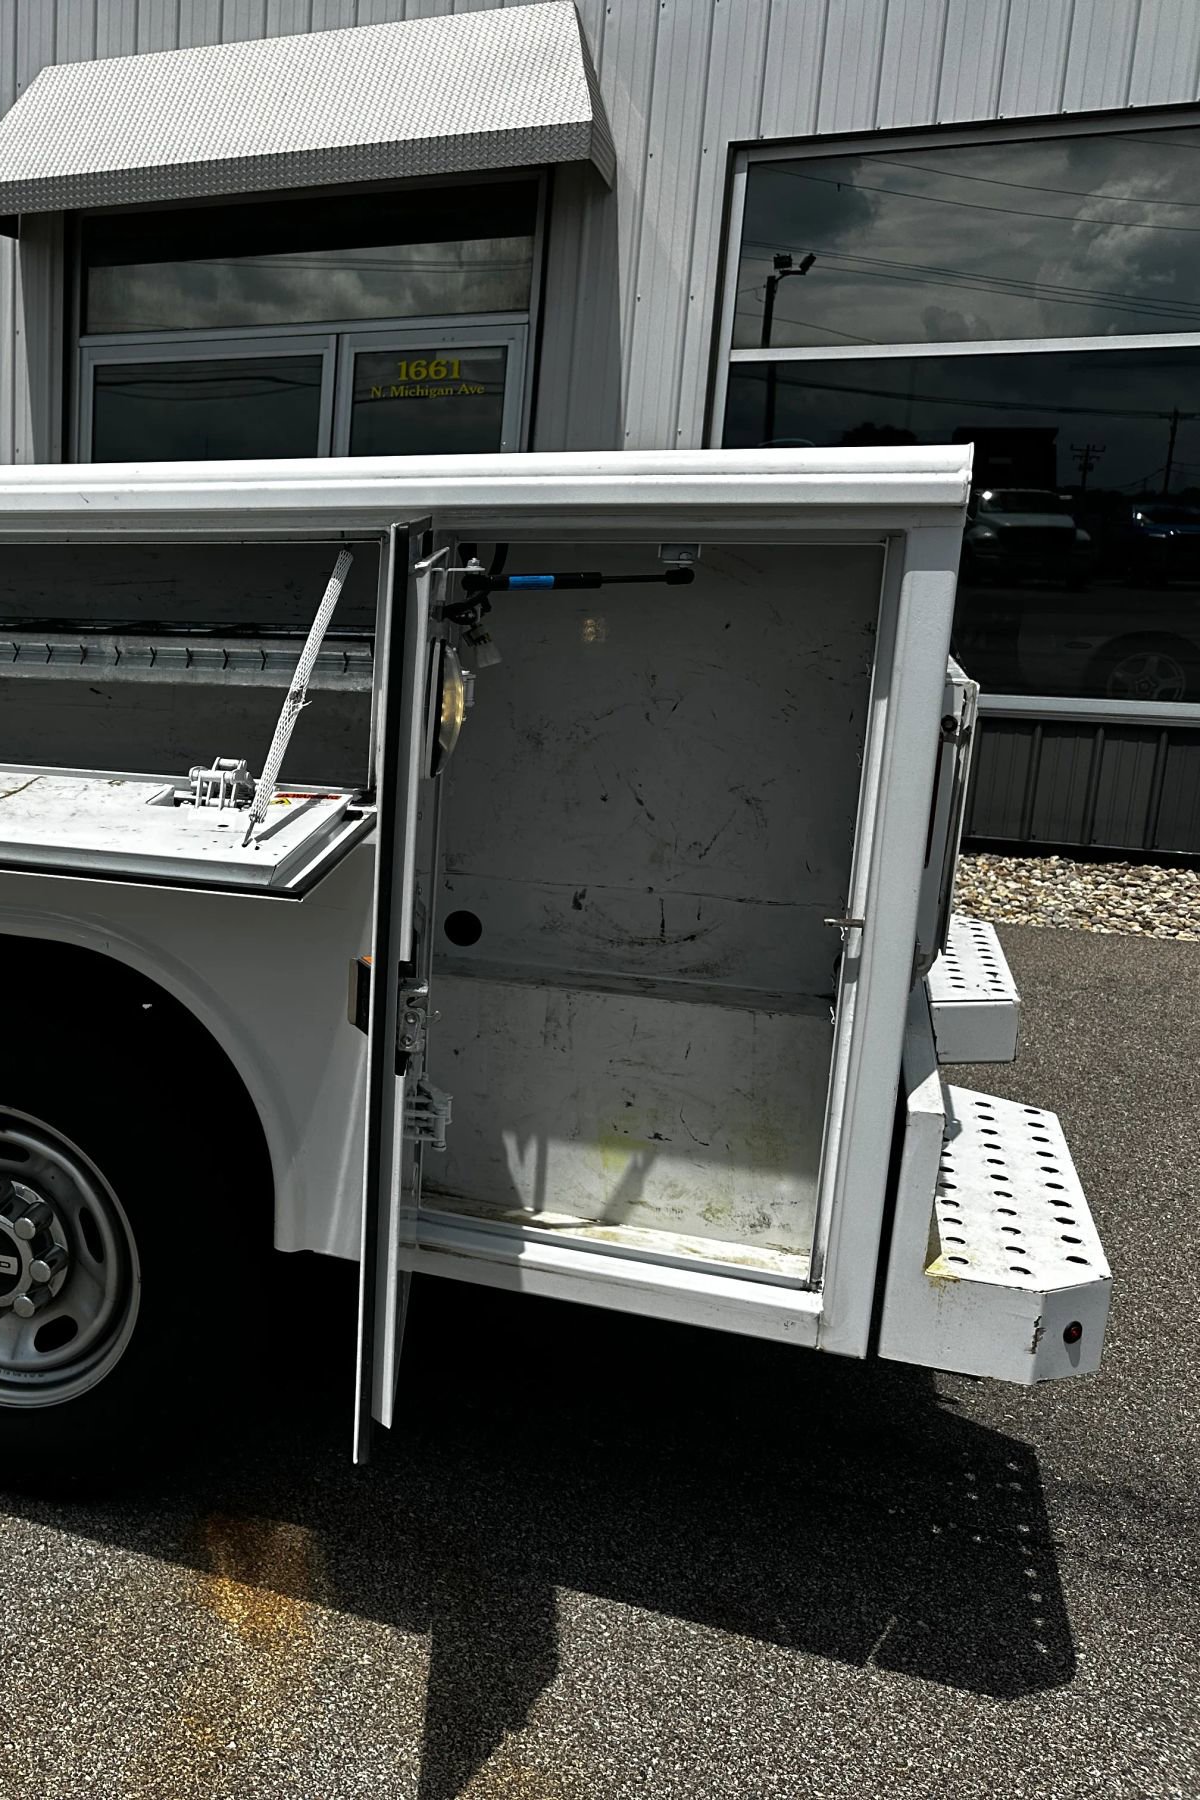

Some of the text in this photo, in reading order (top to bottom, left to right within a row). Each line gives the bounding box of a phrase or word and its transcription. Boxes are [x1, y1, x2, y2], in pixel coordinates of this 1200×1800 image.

[397, 359, 461, 381] 1661
[370, 383, 485, 398] N. Michigan Ave
